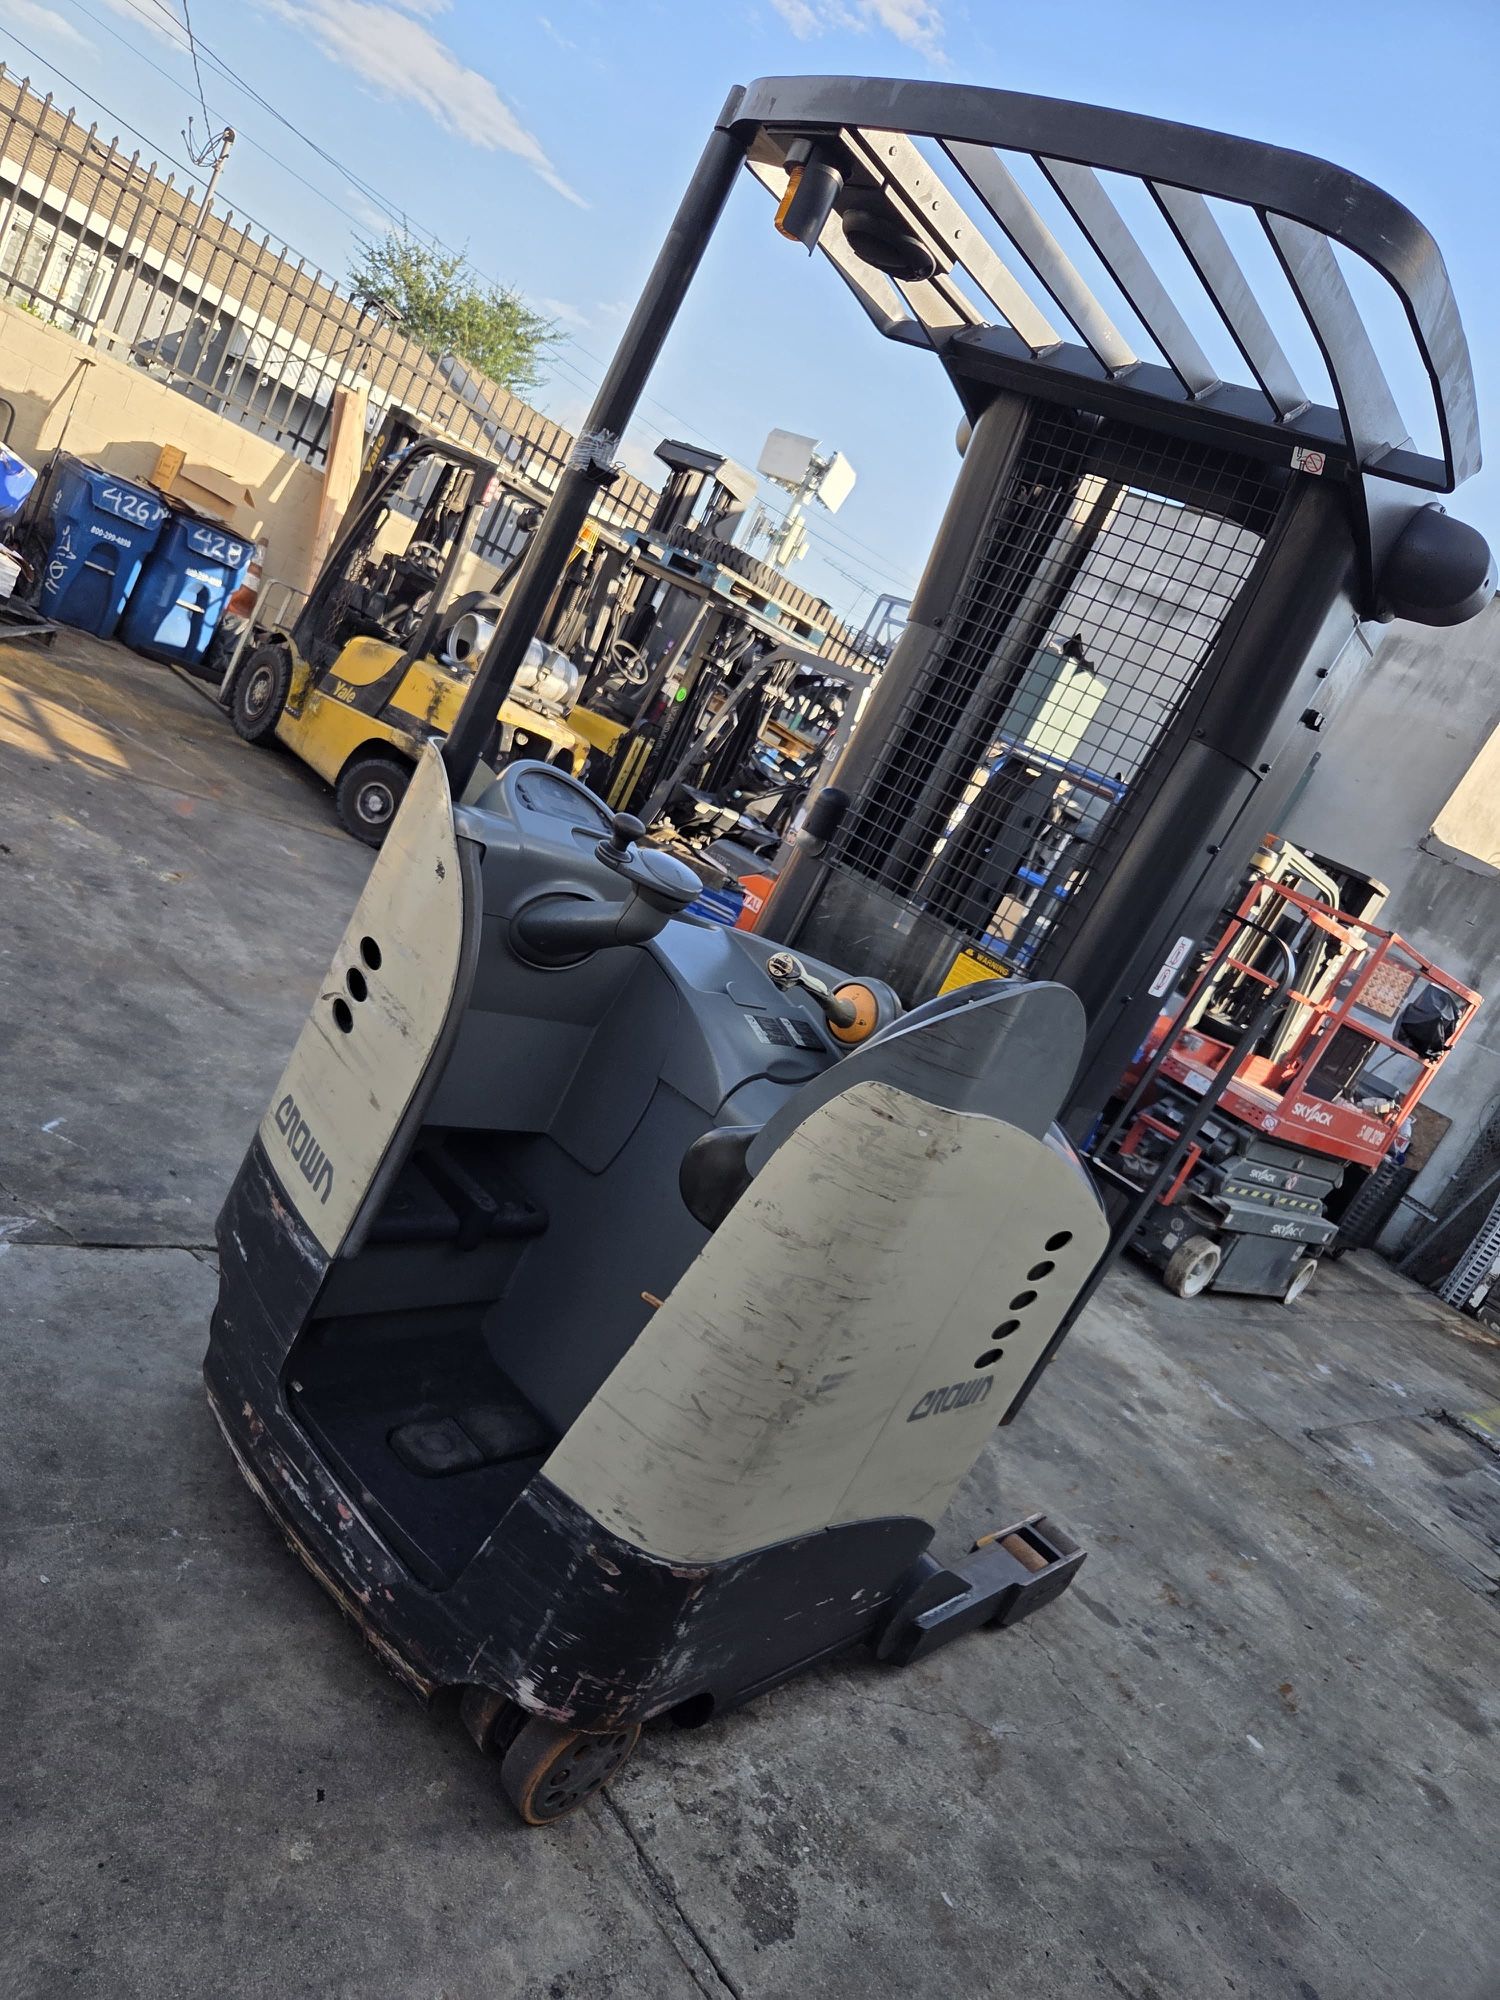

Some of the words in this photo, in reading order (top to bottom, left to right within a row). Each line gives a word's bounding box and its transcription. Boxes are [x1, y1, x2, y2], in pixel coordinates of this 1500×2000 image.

[363, 434, 386, 472] Yale
[102, 487, 150, 522] 426
[193, 528, 243, 566] 428
[332, 680, 357, 704] Yale
[976, 953, 1010, 976] WARNING
[1291, 1102, 1333, 1126] SKYJACK
[275, 1093, 334, 1206] CROWN
[906, 1374, 994, 1424] CROWN
